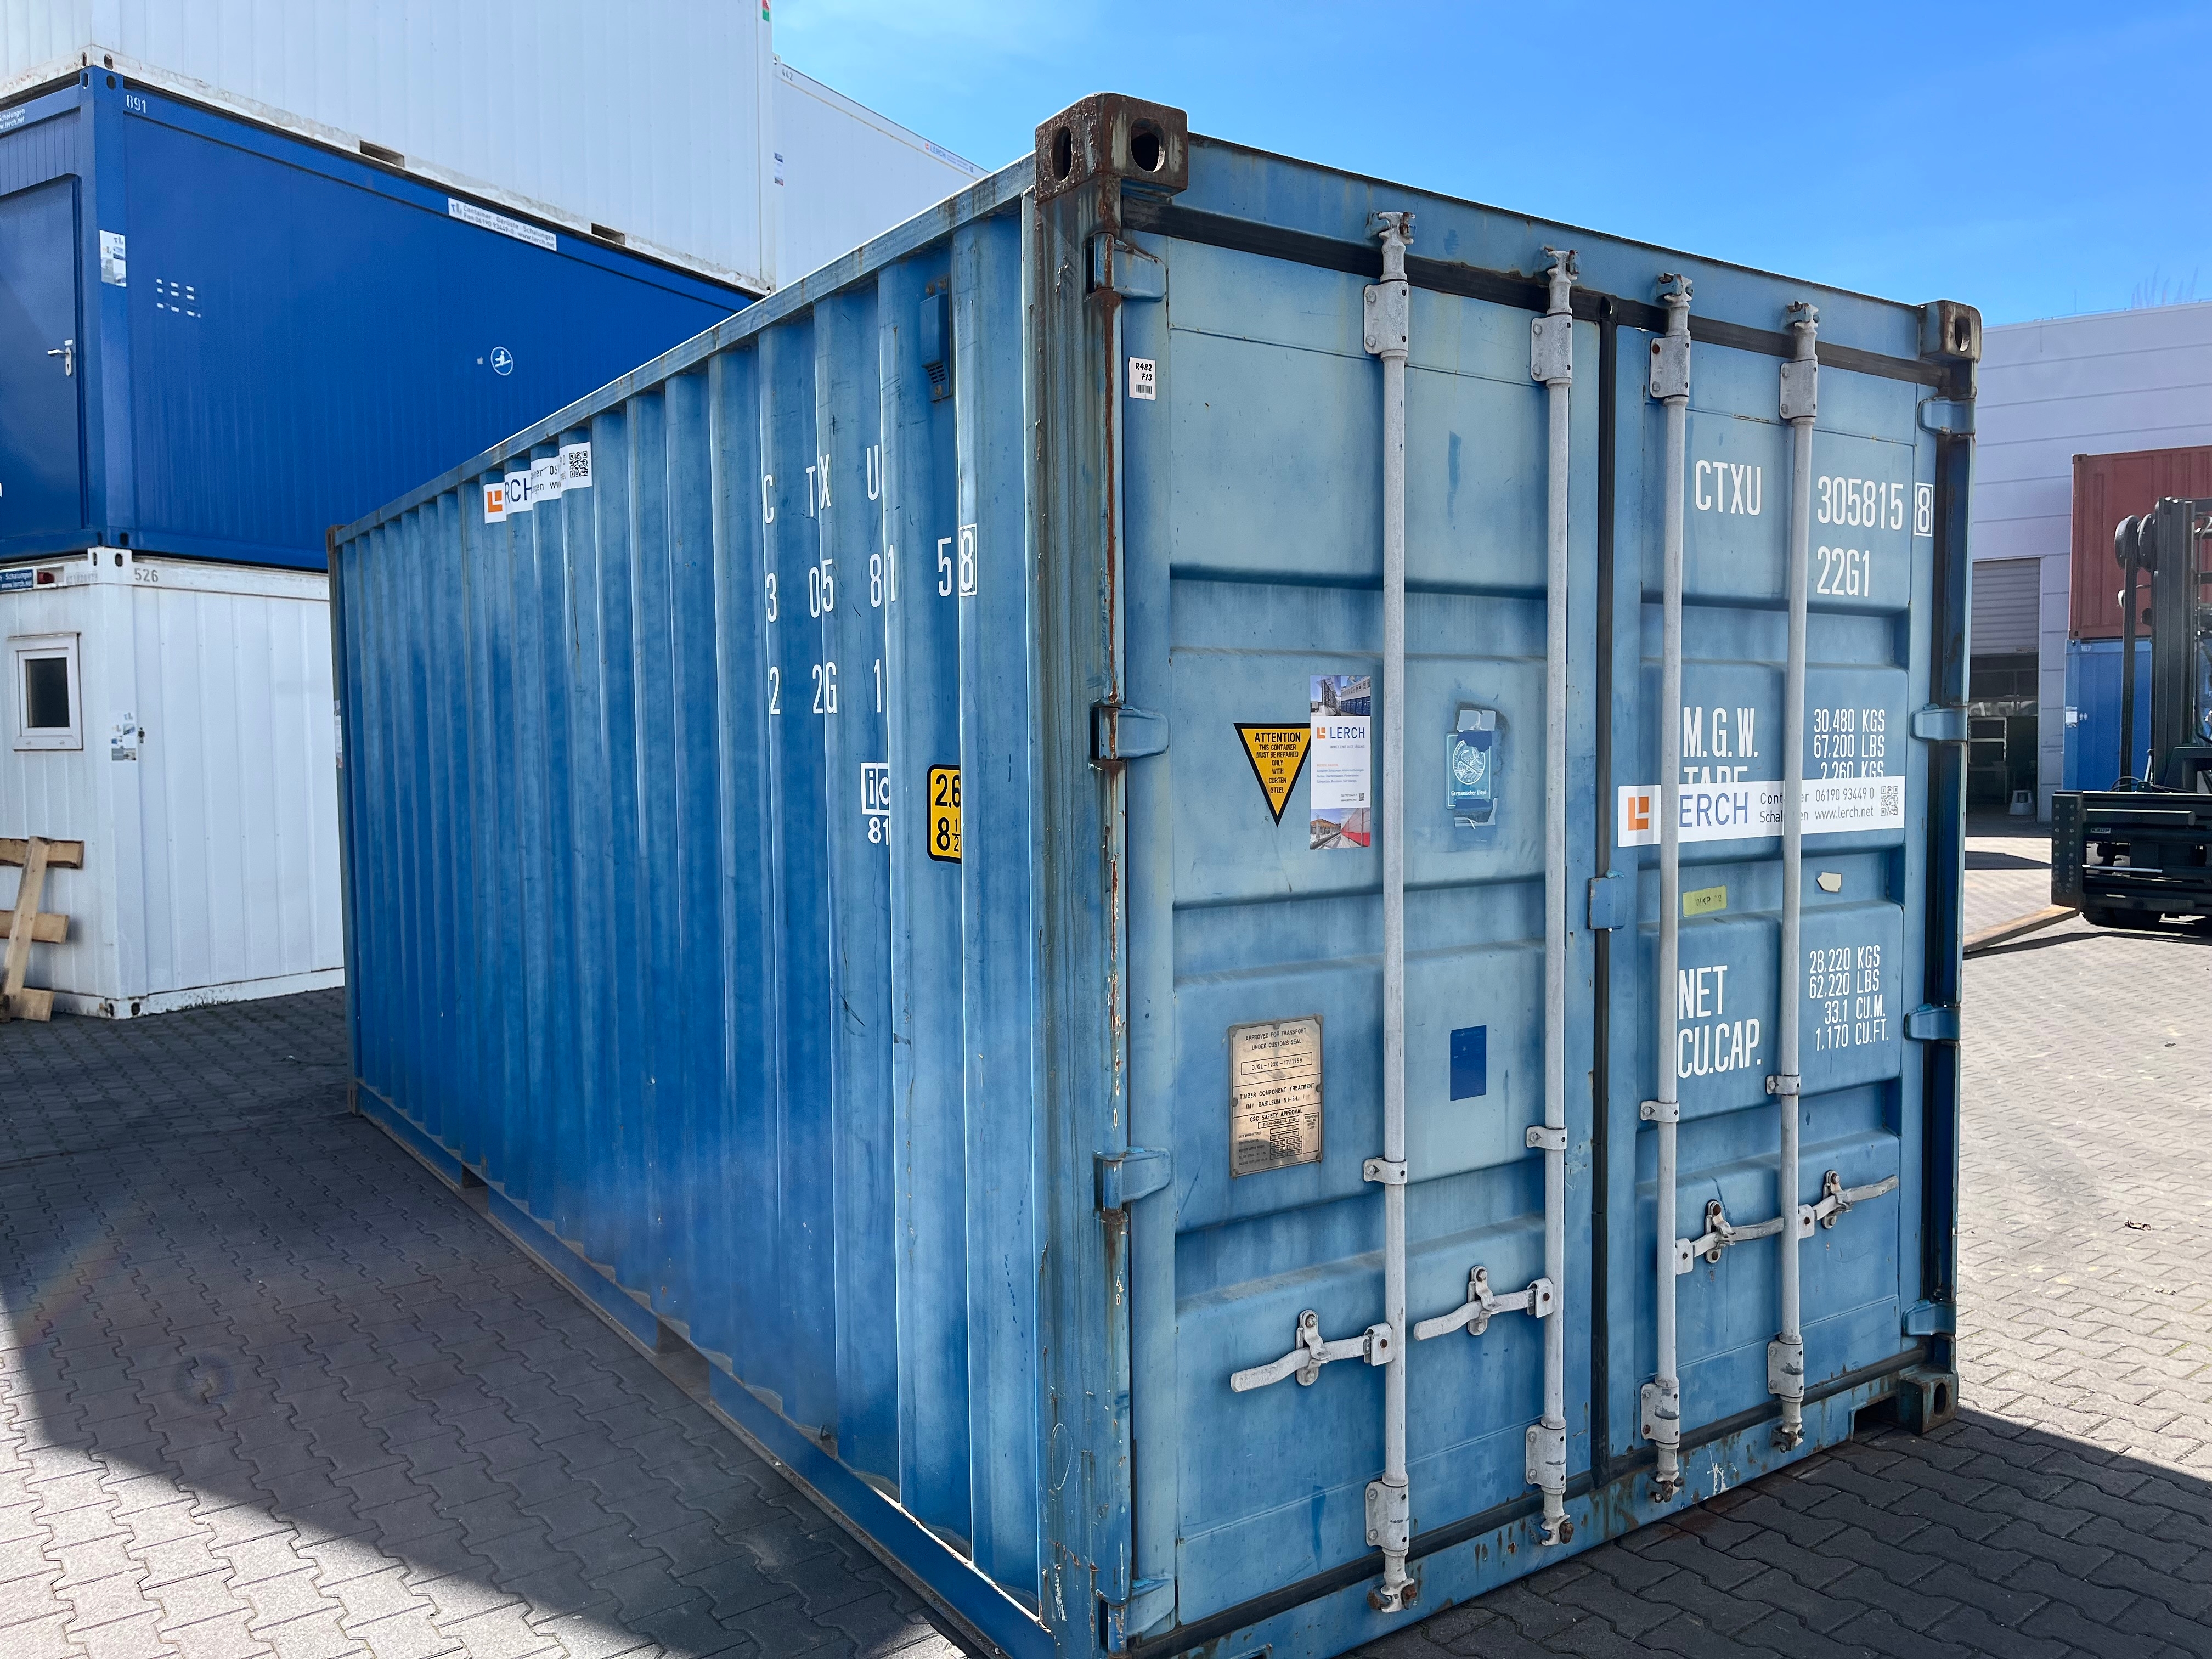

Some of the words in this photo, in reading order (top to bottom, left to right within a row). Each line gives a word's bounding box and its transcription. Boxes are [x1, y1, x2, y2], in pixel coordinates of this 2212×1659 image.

[782, 68, 793, 82] 442
[126, 94, 146, 114] 891
[1135, 362, 1152, 371] R482
[1142, 373, 1153, 381] F13
[1695, 460, 1762, 516] CTXU
[1817, 476, 1904, 531] 305815
[134, 568, 159, 582] 526
[1816, 546, 1870, 597] 22G1
[1814, 708, 1855, 733] 30,480
[1861, 709, 1885, 732] KGS
[1254, 732, 1301, 743] ATTENTION
[1330, 727, 1365, 739] LERCH
[1814, 734, 1855, 758] 67,200
[1861, 734, 1885, 758] LBS
[1861, 760, 1884, 778] KGS
[1477, 789, 1487, 797] Lloyd
[1679, 792, 1748, 828] ERCH
[1815, 789, 1839, 802] 06190
[1843, 787, 1866, 800] 93449
[1869, 787, 1874, 799] 0
[1815, 806, 1874, 820] www.lerch.net
[1678, 964, 1728, 1020] NET
[1809, 947, 1850, 974] 28,220
[1857, 944, 1880, 969] KGS
[1809, 972, 1850, 999] 62,220
[1857, 968, 1880, 994] LBS
[1824, 998, 1847, 1024] 33.1
[1856, 994, 1886, 1020] CU.M.
[1245, 1032, 1269, 1041] APPROVED
[1281, 1028, 1307, 1036] TRANSPORT
[1268, 1040, 1289, 1048] CUSTOMS
[1677, 1018, 1762, 1079] CU.CAP.
[1815, 1024, 1848, 1051] 1,170
[1855, 1018, 1889, 1046] CU.FT.
[1259, 1087, 1286, 1096] COMPONENT
[1289, 1082, 1314, 1092] TREATMENT
[1258, 1099, 1280, 1107] BASILEUM
[1261, 1112, 1278, 1120] SAFETY
[1280, 1108, 1303, 1117] APPROVAL
